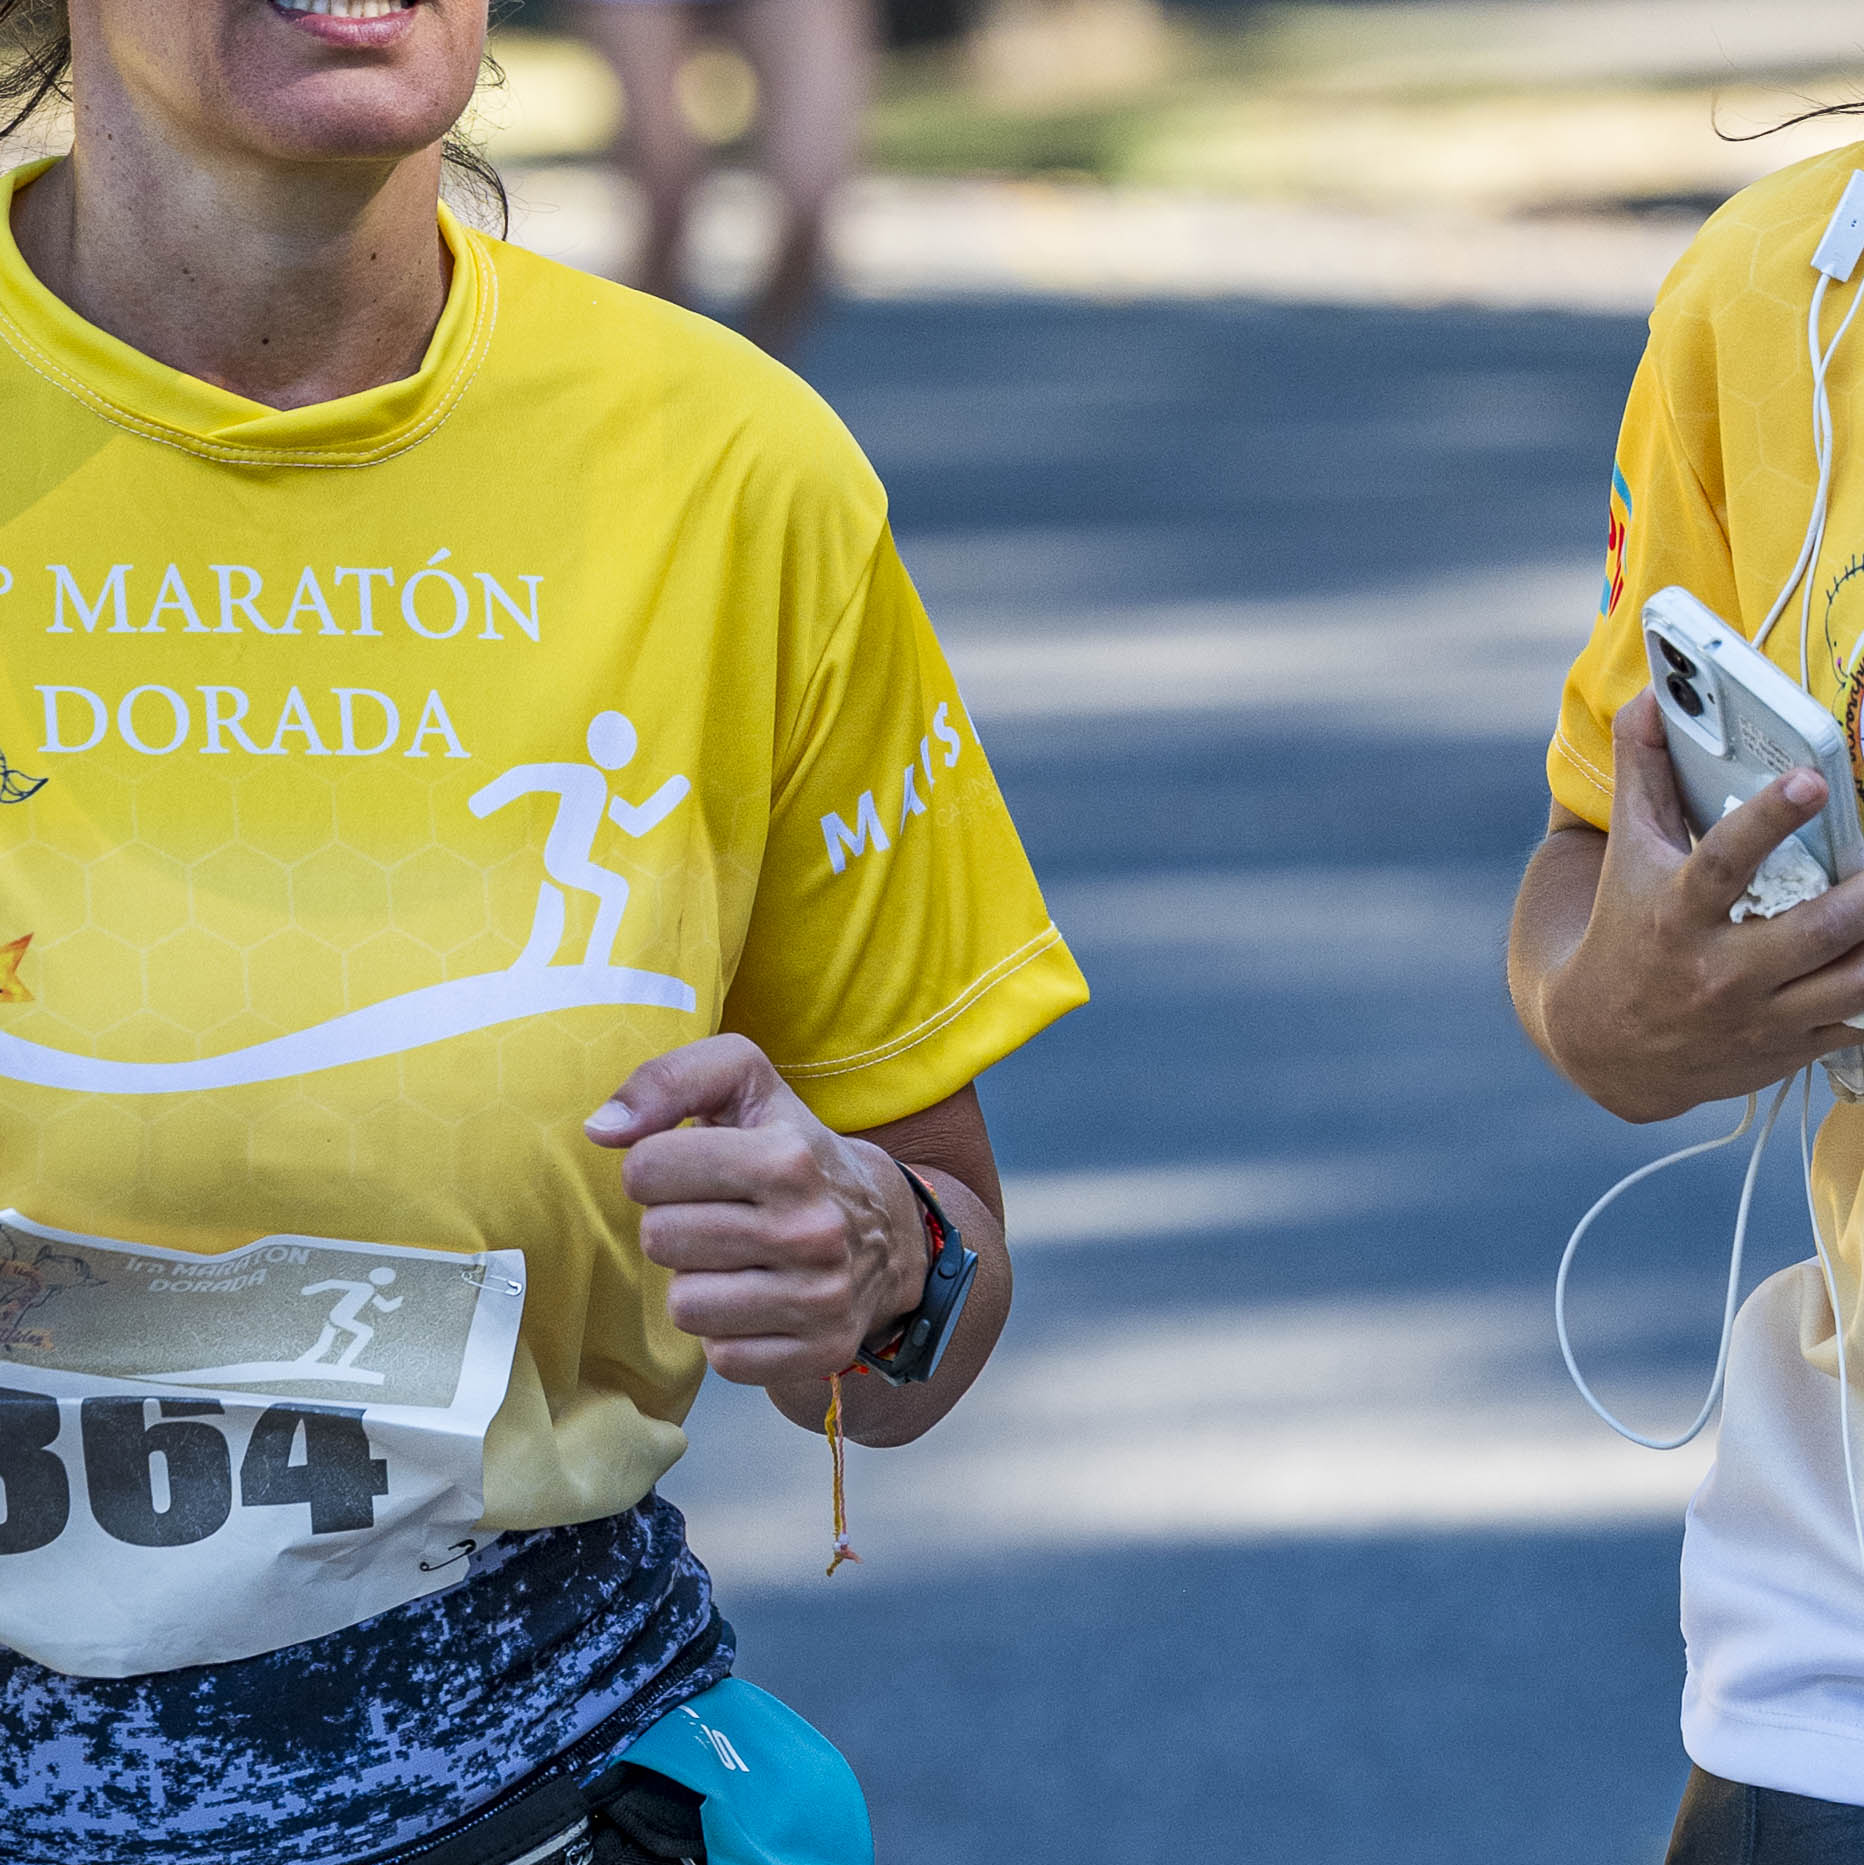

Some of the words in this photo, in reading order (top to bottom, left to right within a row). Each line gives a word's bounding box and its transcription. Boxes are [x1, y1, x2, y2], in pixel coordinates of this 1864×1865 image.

[46, 548, 544, 643] MARATÓN
[35, 684, 471, 759] DORADA
[148, 1268, 268, 1292] DORADA
